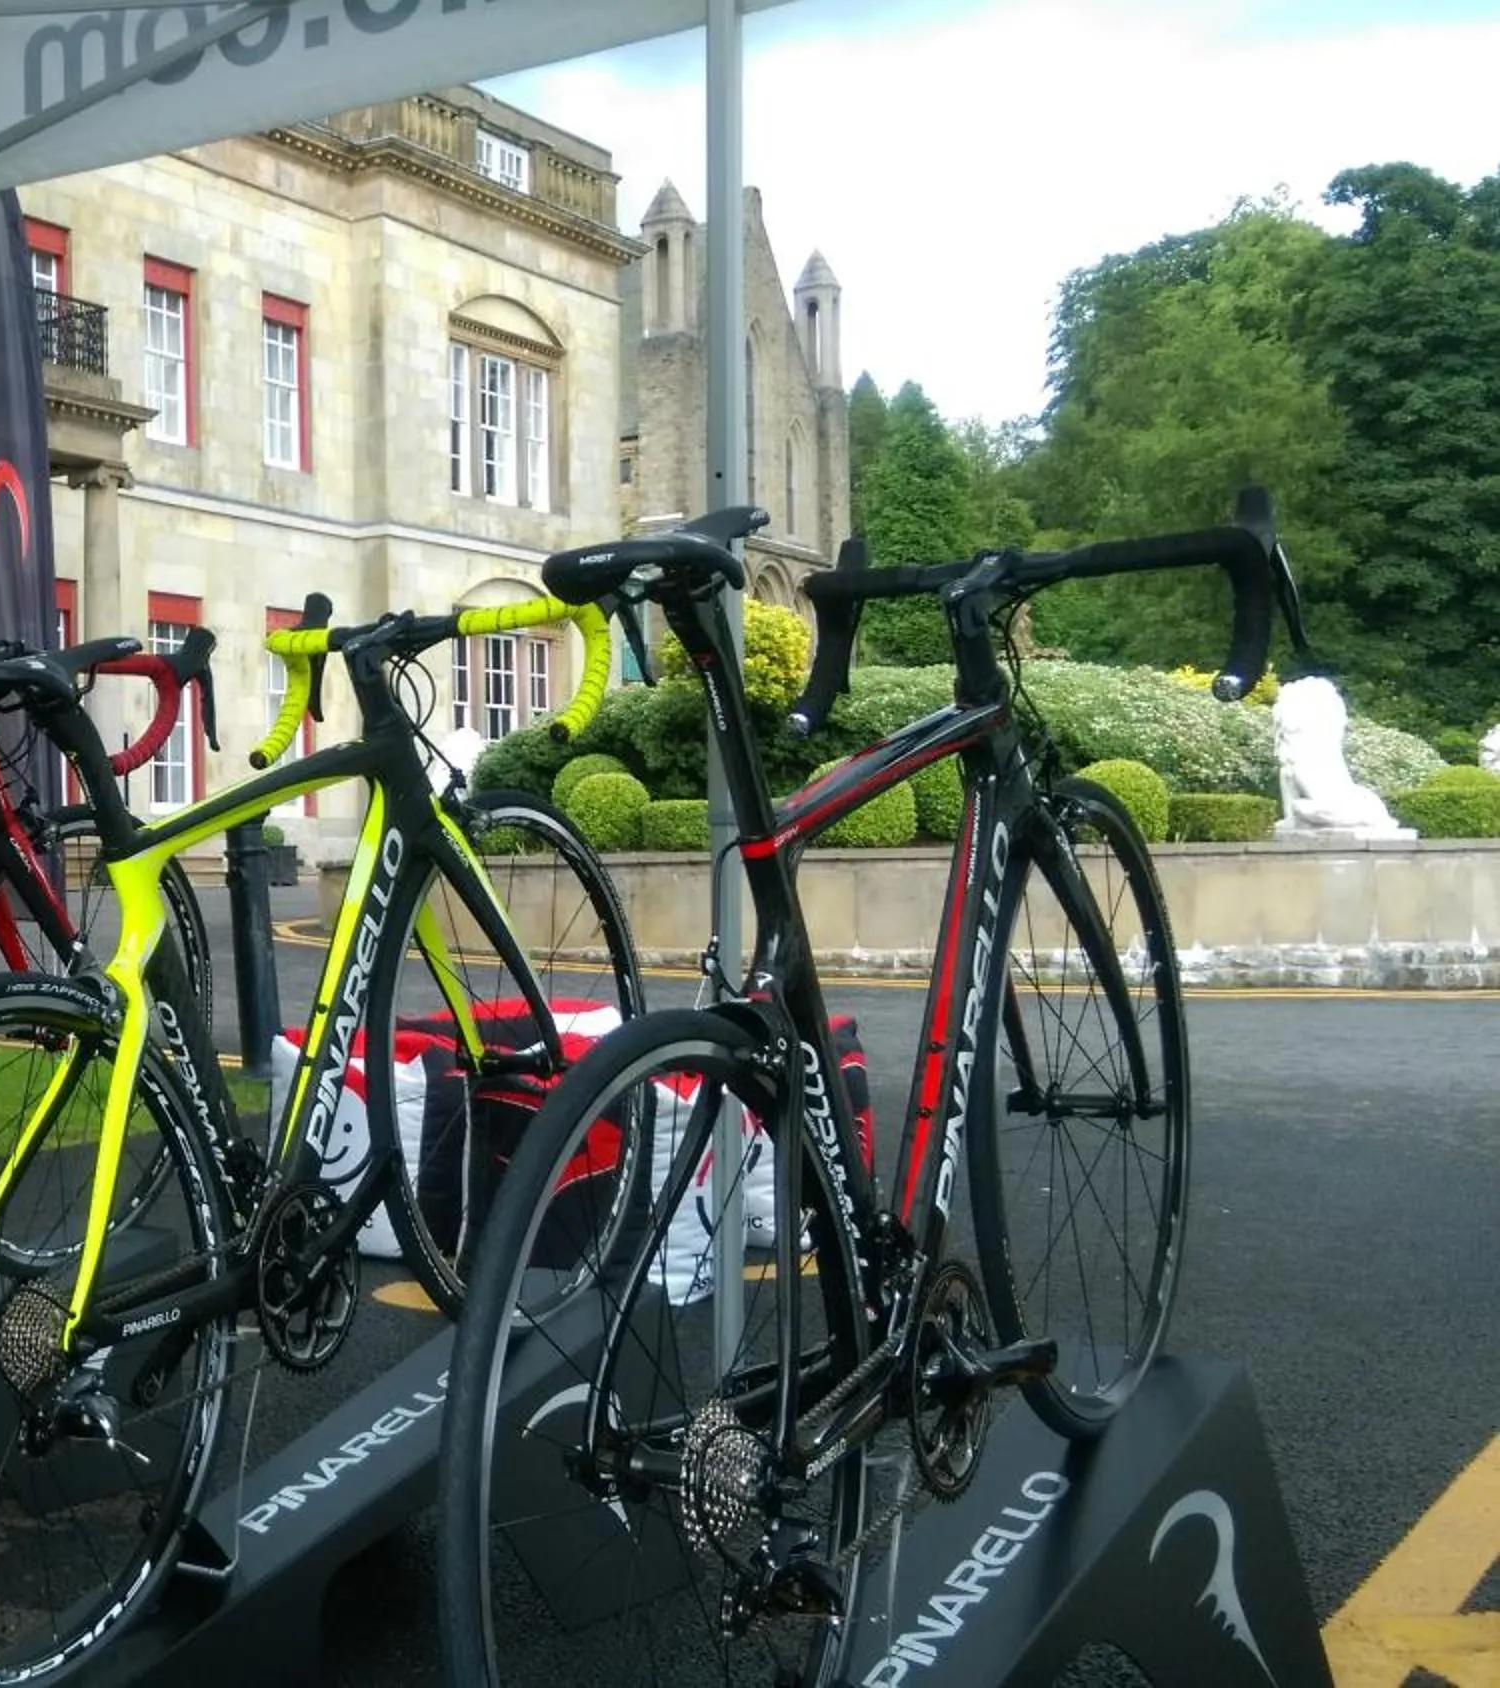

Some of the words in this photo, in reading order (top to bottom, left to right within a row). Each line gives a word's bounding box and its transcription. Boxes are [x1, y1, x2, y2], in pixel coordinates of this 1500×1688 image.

[580, 553, 615, 565] MOST
[305, 828, 403, 1157] PINARELLO
[935, 821, 1009, 1222] PINARELLO
[121, 1309, 181, 1338] PINARELLO
[861, 1471, 1071, 1688] PINARELLO
